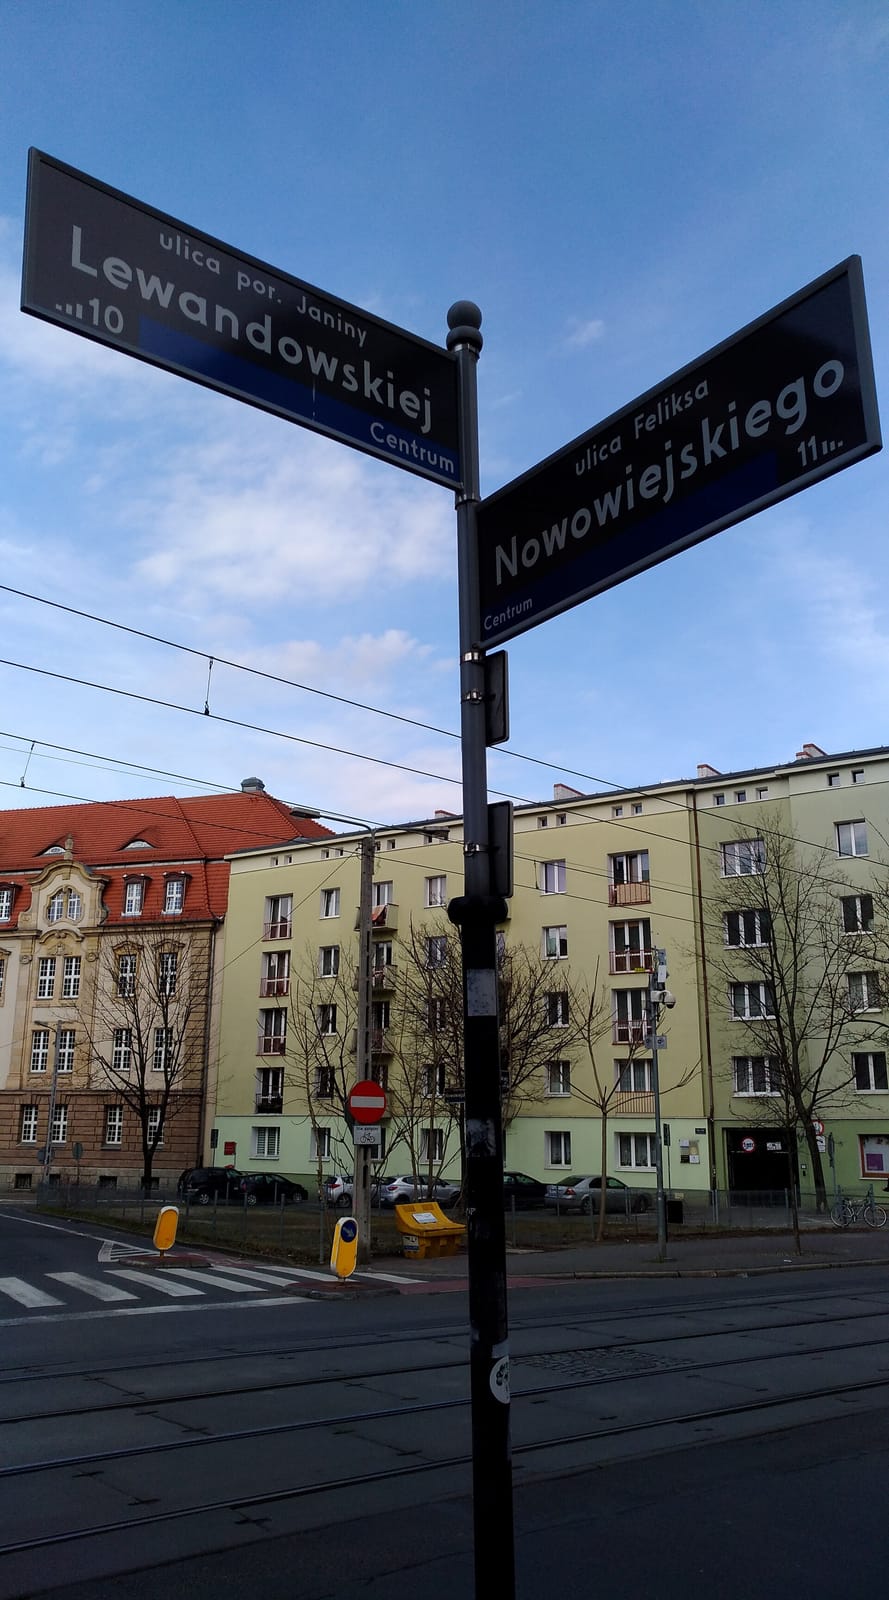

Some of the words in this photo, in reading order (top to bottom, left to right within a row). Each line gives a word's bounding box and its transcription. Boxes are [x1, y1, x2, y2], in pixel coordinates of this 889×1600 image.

[89, 298, 124, 335] 10
[160, 232, 221, 275] ulica
[238, 270, 282, 304] por.
[297, 296, 367, 348] Janiny
[71, 225, 432, 434] Lewandowskiej
[370, 422, 455, 474] Centrum
[575, 435, 622, 476] ulica
[634, 378, 709, 440] Feliksa
[797, 436, 819, 467] 11
[495, 359, 845, 585] Nowowiejskiego
[484, 596, 533, 631] Centrum
